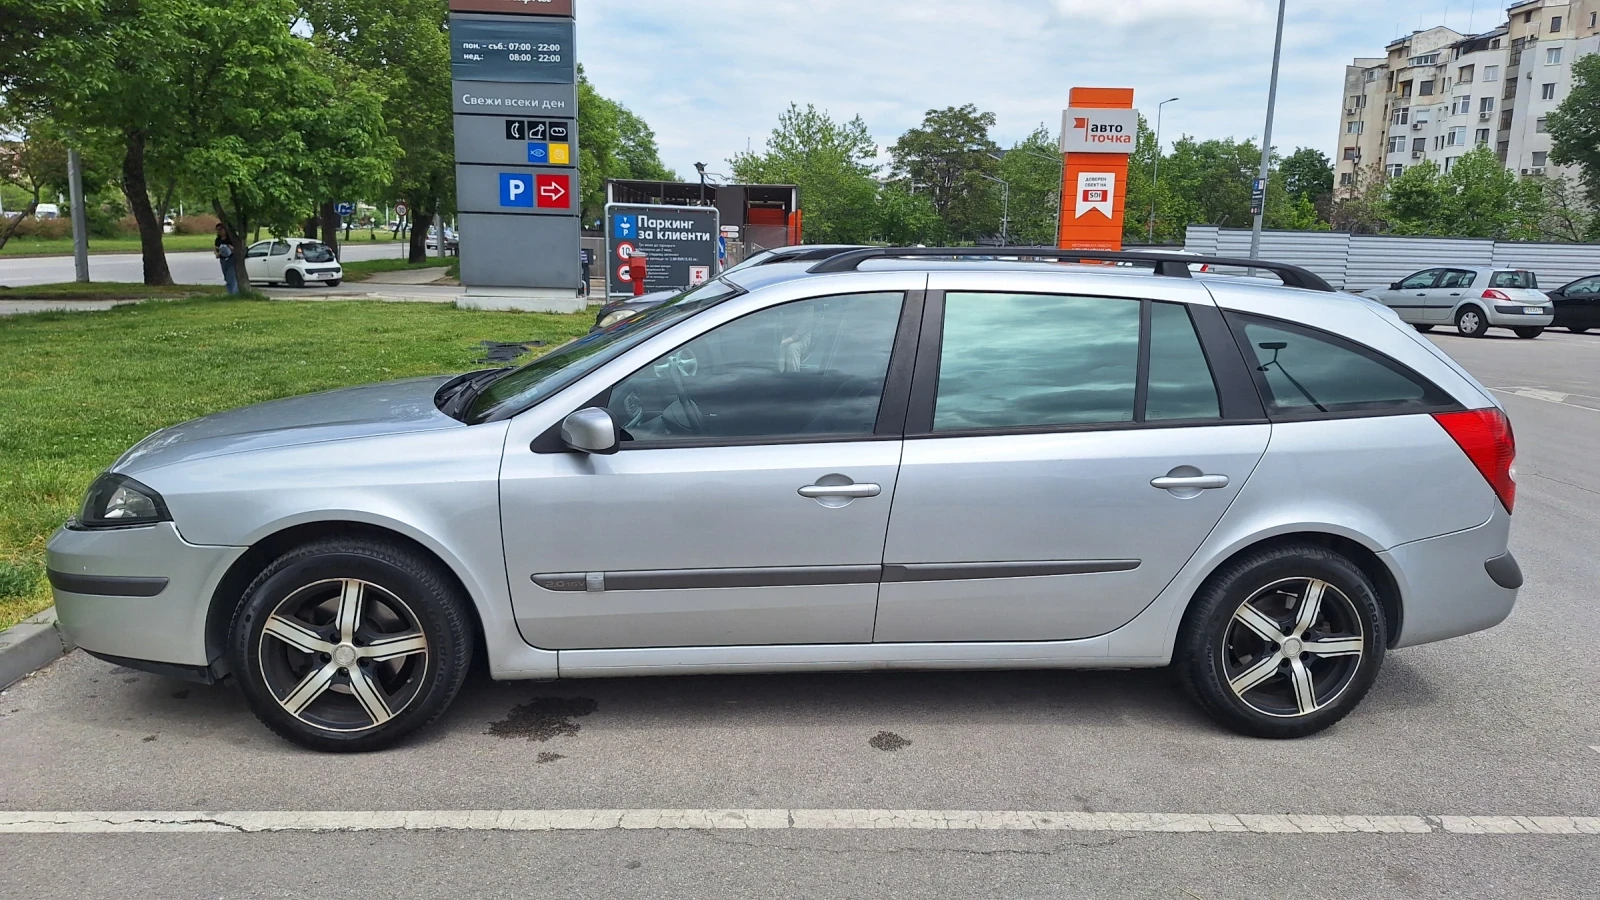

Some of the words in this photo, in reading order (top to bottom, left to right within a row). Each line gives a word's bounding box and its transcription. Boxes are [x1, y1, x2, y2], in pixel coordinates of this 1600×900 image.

[508, 42, 531, 51] 07:00
[538, 43, 560, 51] 22:00
[509, 53, 531, 62] 08:00
[538, 54, 561, 62] 22:00
[462, 94, 502, 106] Свежи
[505, 98, 539, 107] всеки
[542, 100, 565, 109] ден
[1091, 124, 1123, 133] авто
[1091, 134, 1131, 143] точка
[509, 179, 525, 201] P
[637, 215, 694, 230] Паркинг
[638, 231, 654, 240] за
[657, 230, 710, 241] клиенти
[622, 247, 631, 256] 10
[545, 580, 565, 588] 2.0
